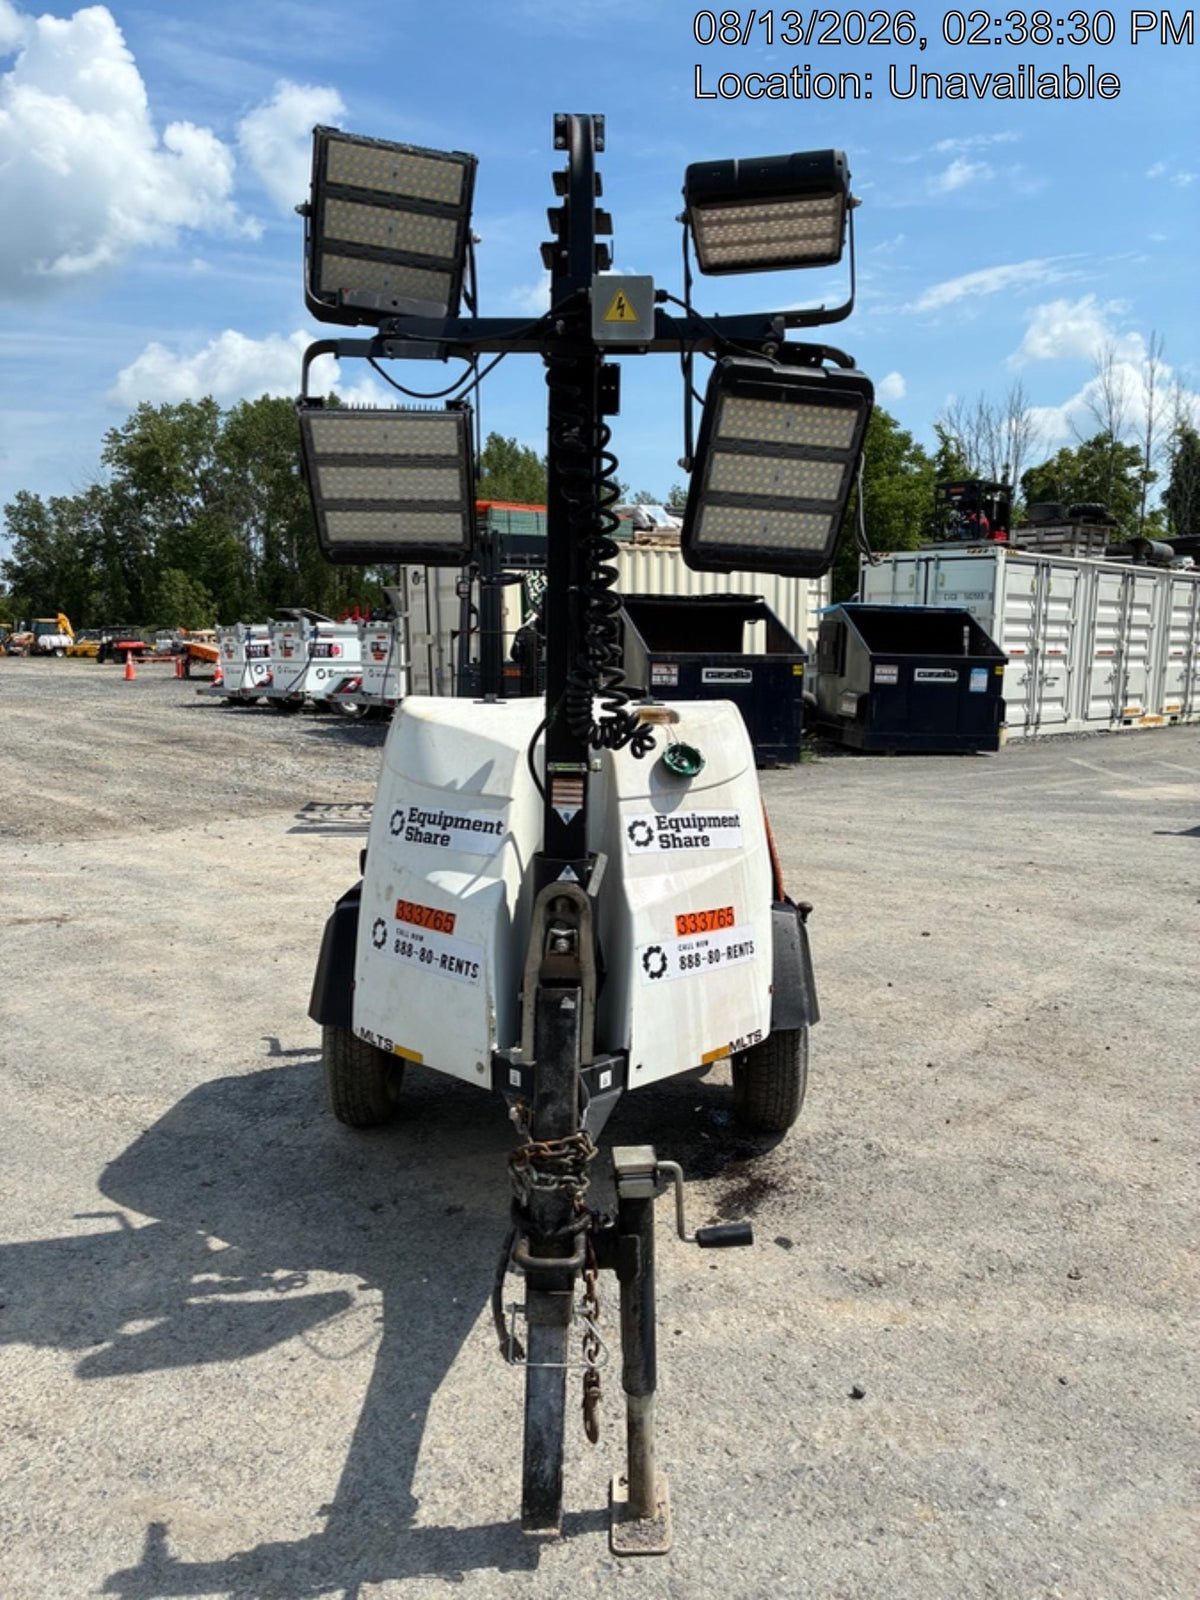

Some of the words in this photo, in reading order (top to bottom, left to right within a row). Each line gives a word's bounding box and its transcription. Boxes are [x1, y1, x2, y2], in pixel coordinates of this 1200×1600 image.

[407, 806, 504, 835] Equipment
[655, 812, 740, 833] Equipment
[404, 826, 451, 847] Share
[658, 833, 710, 849] Share
[395, 899, 456, 934] 333765
[676, 906, 735, 935] 333765
[394, 939, 479, 979] 888-80-RENTS
[679, 940, 754, 971] 888-80-RENTS
